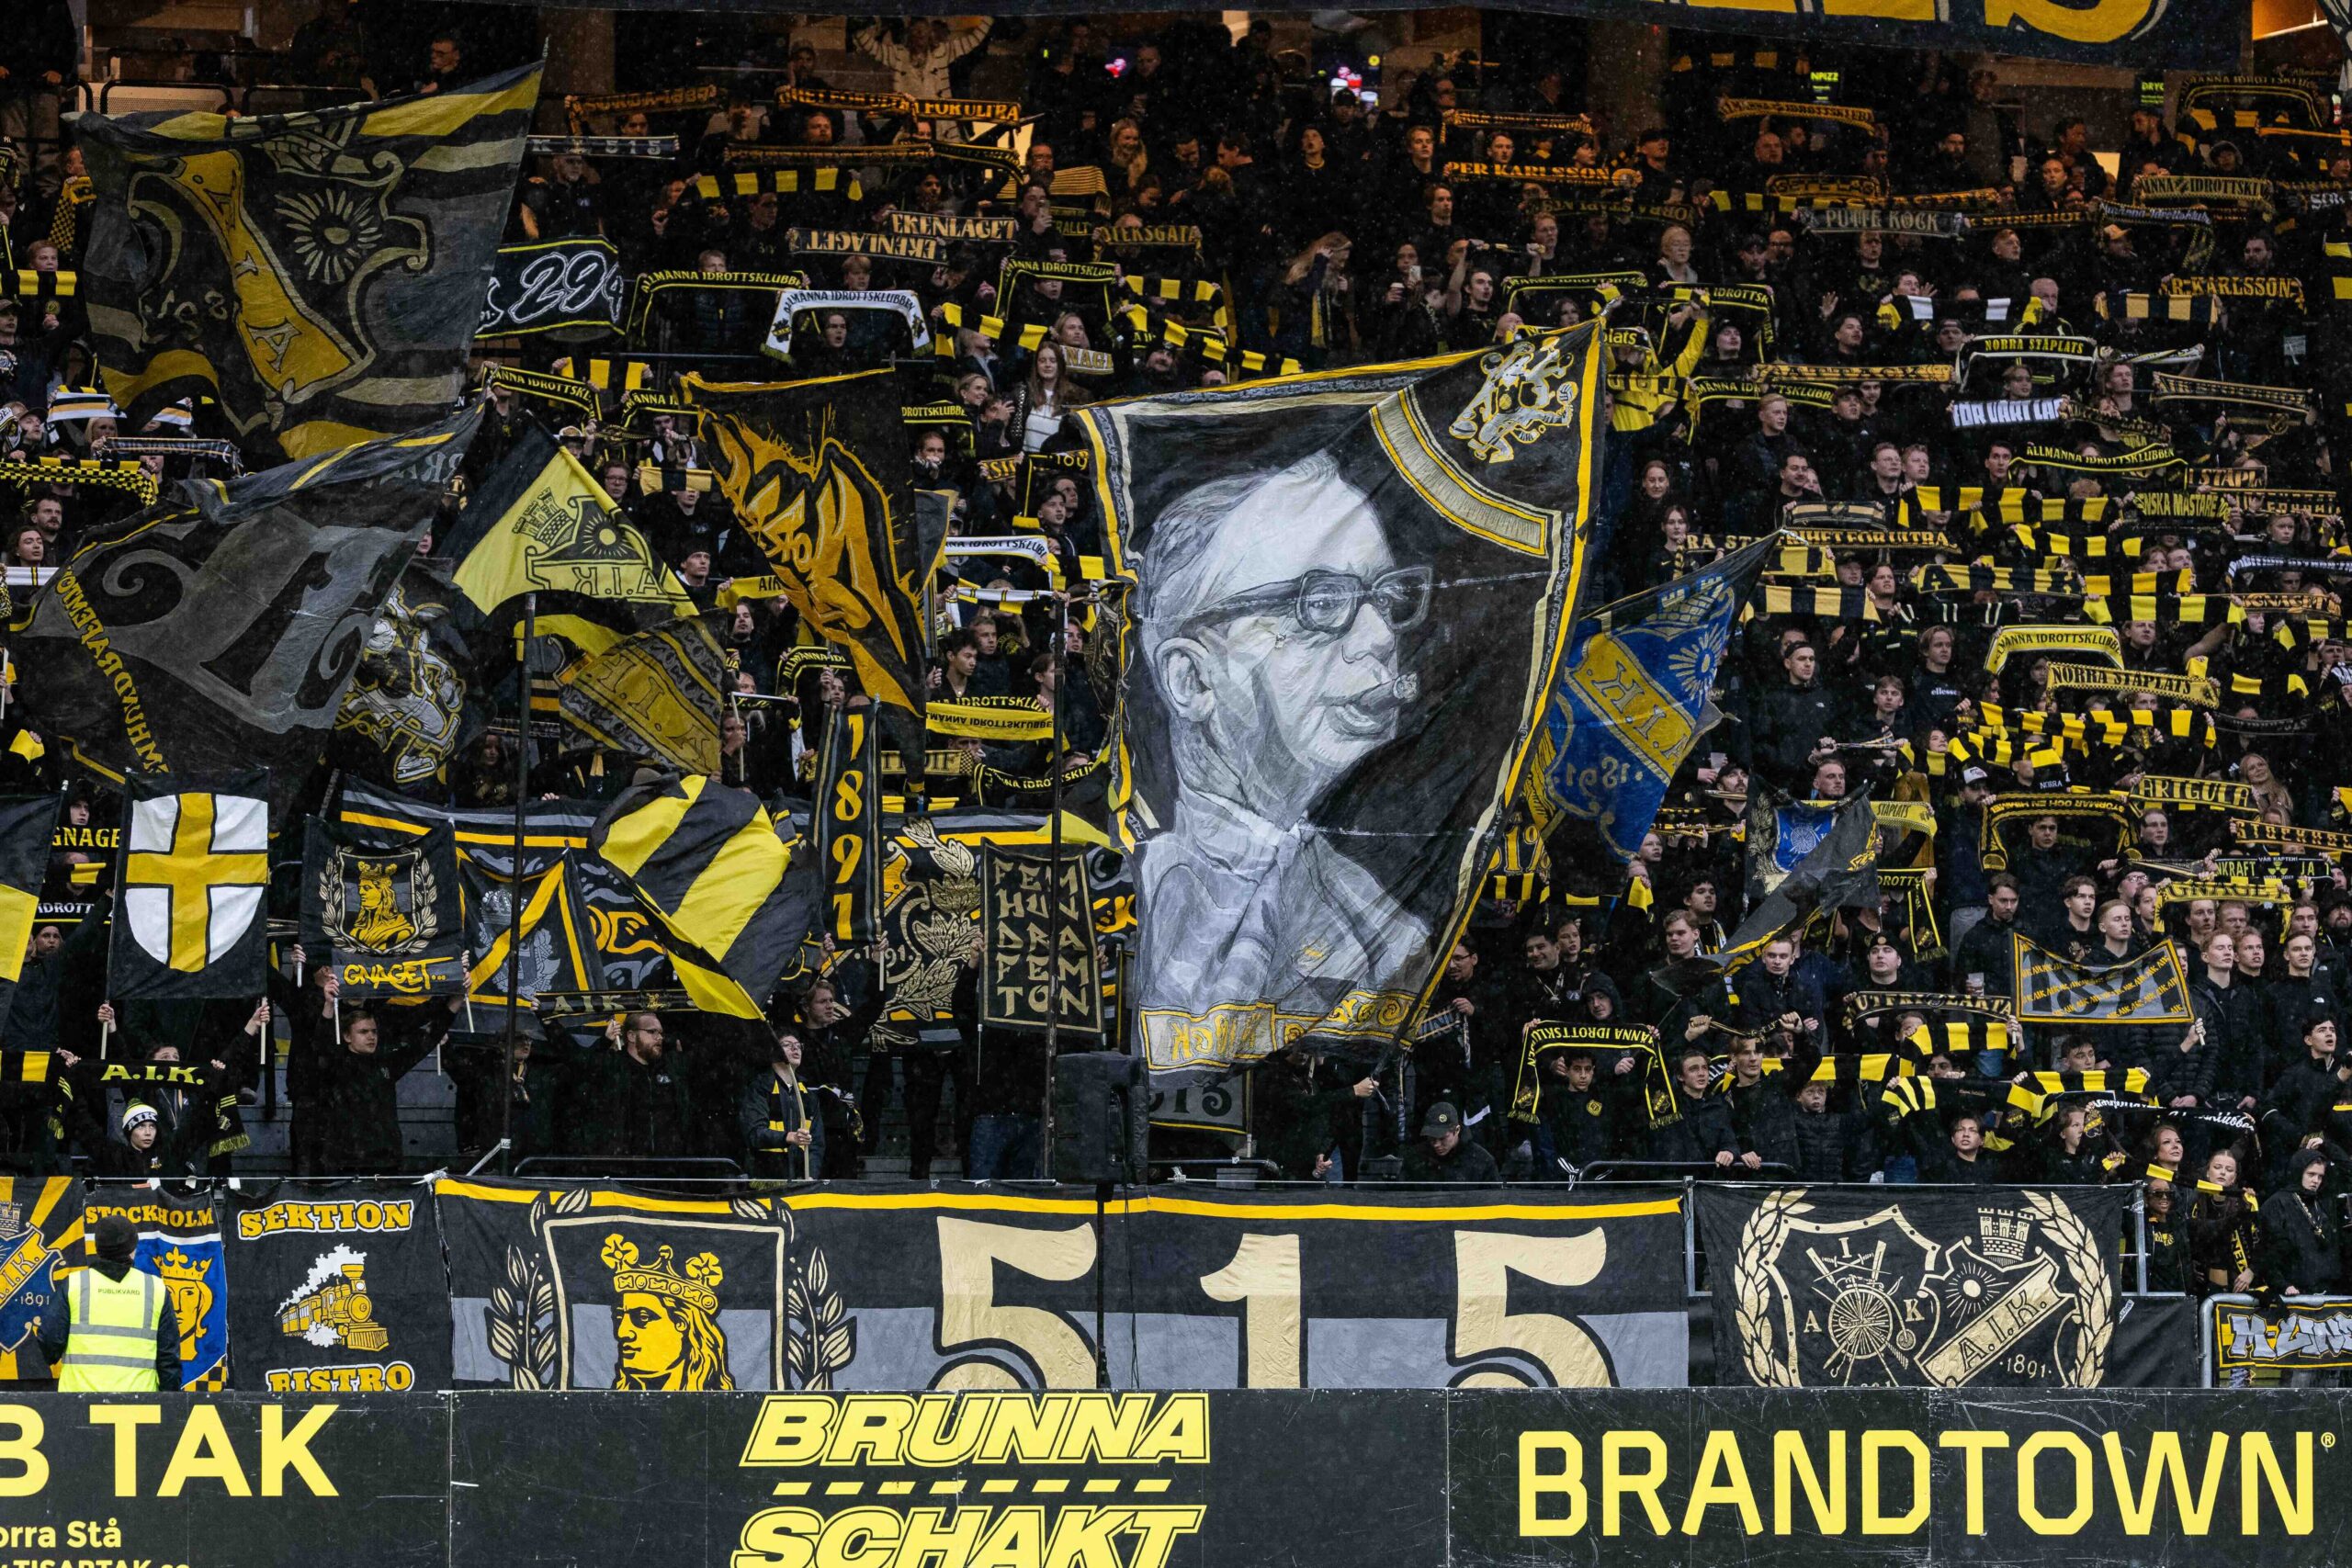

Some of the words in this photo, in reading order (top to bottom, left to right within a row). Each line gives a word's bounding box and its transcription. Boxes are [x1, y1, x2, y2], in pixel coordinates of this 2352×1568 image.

[605, 138, 662, 155] 515
[1447, 161, 1489, 176] PER
[1494, 164, 1610, 181] KARLSSON
[891, 212, 1016, 241] EKENLAGET
[806, 230, 937, 261] EKENLAGET
[1984, 338, 2024, 351] NORRA
[2052, 666, 2107, 686] NORRA
[997, 920, 1087, 953] DRA
[996, 952, 1089, 987] FEM
[553, 994, 627, 1012] AIK
[997, 985, 1090, 1017] TON
[101, 1064, 204, 1086] A.I.K.
[85, 1204, 214, 1228] STOCKHOLM
[240, 1201, 412, 1238] SEKTION
[1960, 1286, 2048, 1374] A.I.K.
[268, 1363, 413, 1392] BISTRO
[740, 1392, 1211, 1467] BRUNNA
[89, 1404, 340, 1497] TAK
[1519, 1429, 2313, 1537] BRANDTOWN
[67, 1517, 122, 1549] Stå
[730, 1504, 1208, 1568] SCHAKT
